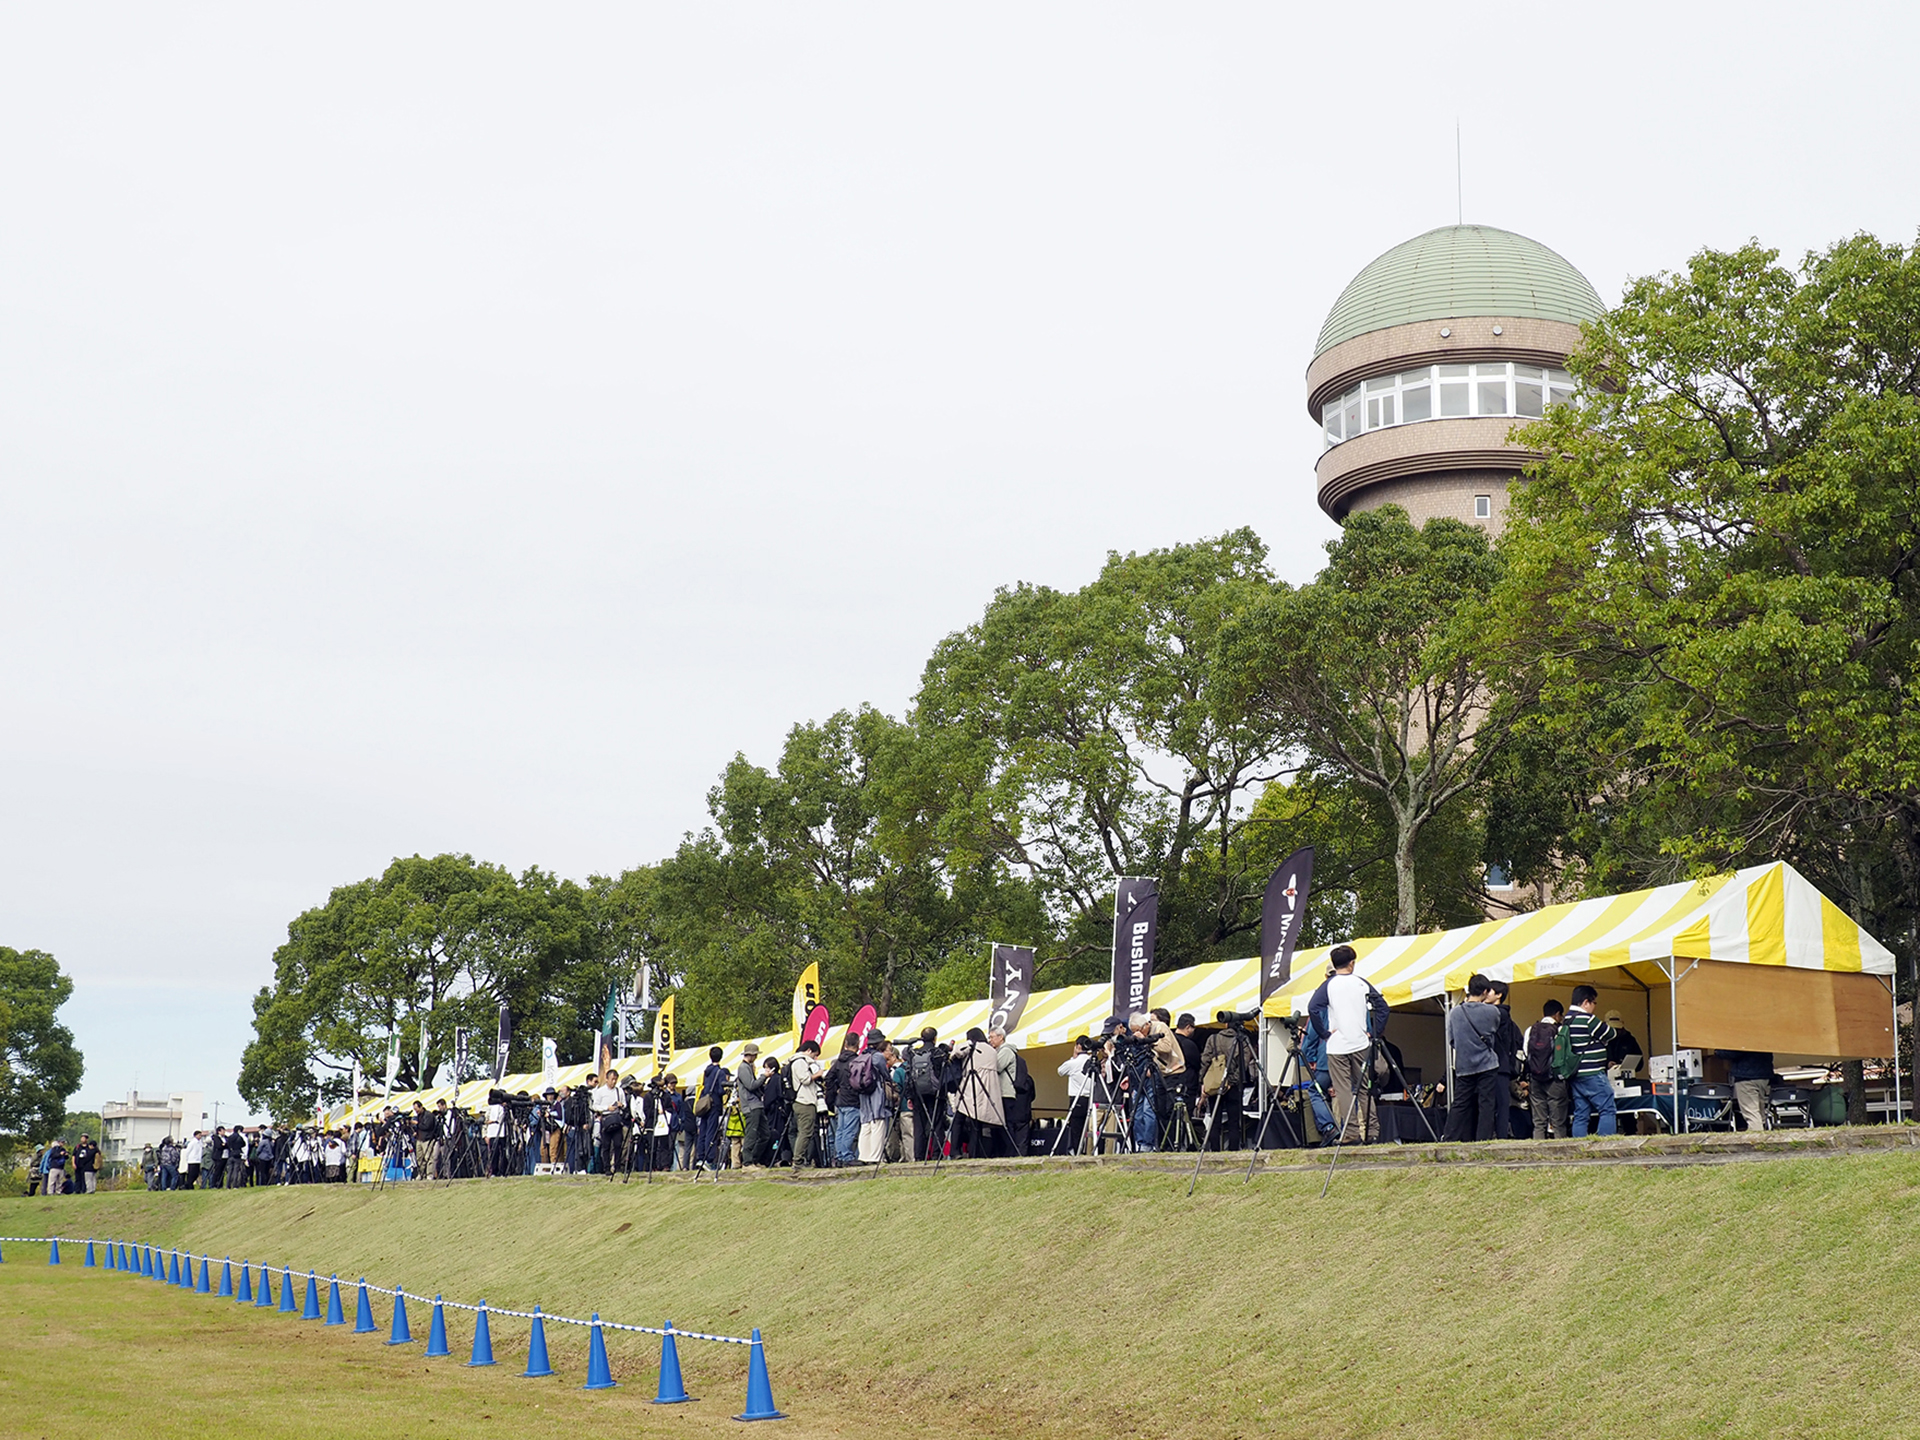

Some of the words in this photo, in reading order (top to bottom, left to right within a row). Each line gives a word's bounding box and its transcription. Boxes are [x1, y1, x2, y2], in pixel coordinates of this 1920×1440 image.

[1128, 921, 1150, 1009] Bushnell
[1269, 913, 1295, 978] MAVEN
[991, 959, 1022, 1029] ONY
